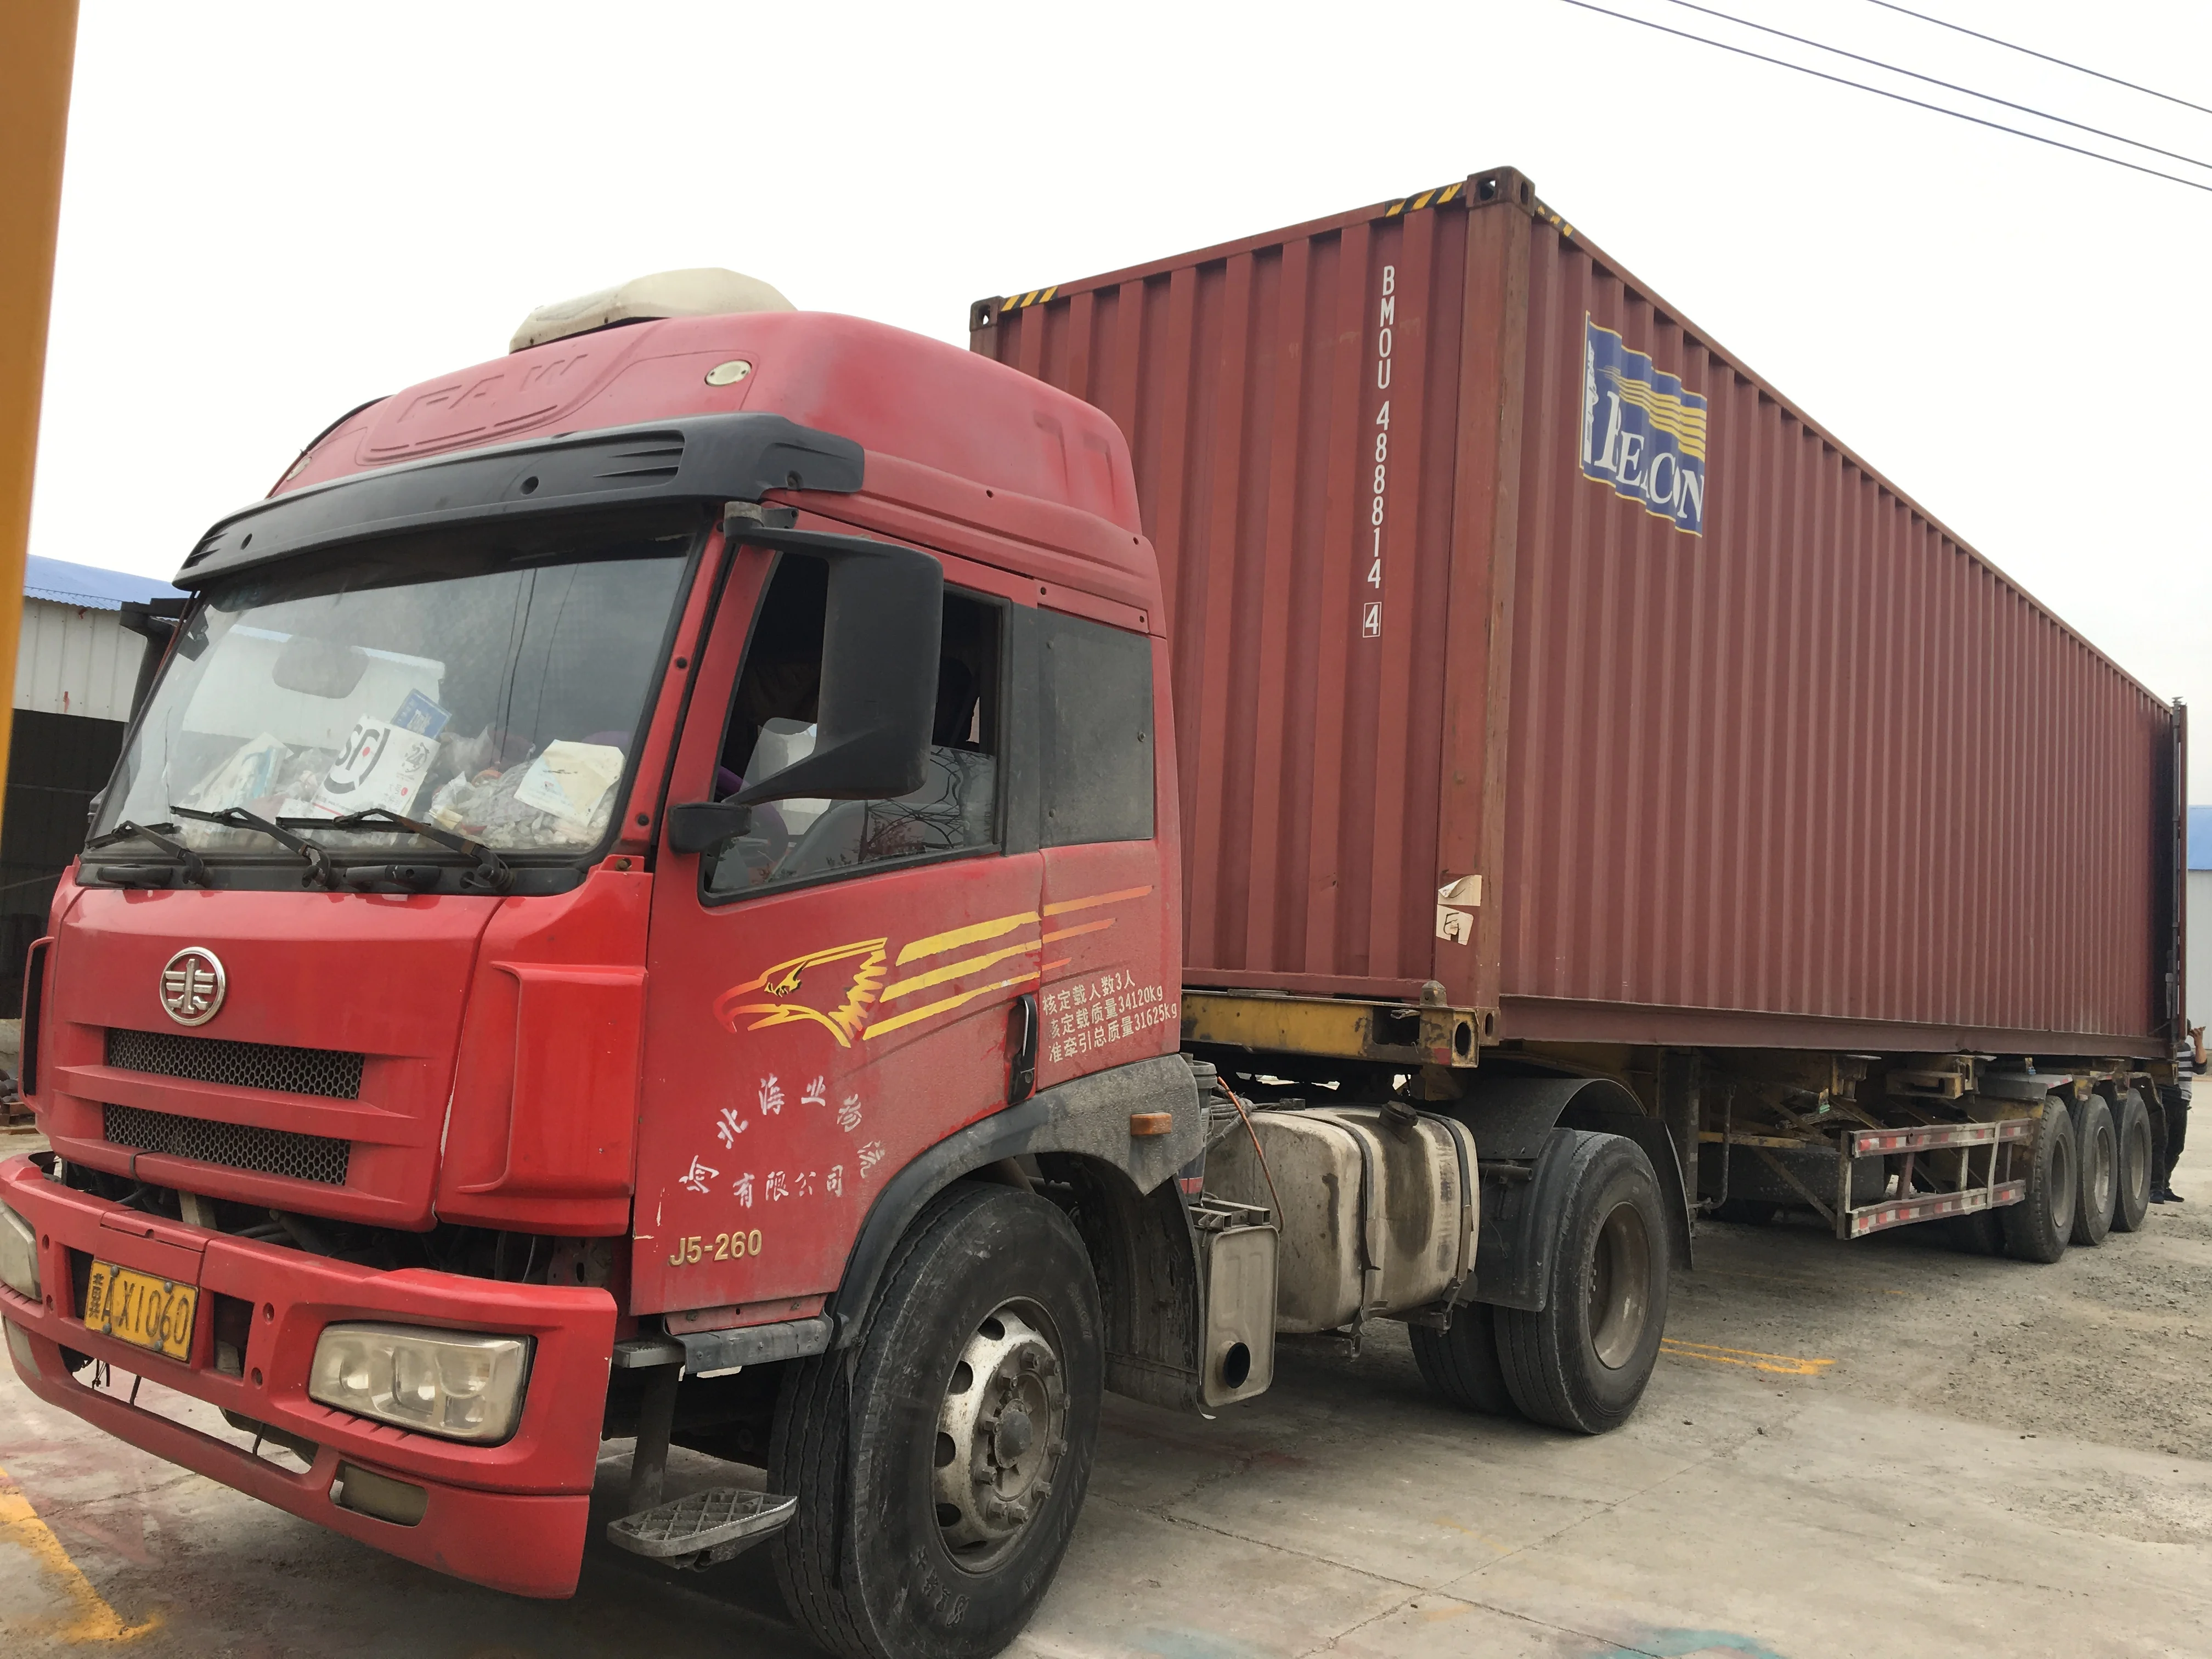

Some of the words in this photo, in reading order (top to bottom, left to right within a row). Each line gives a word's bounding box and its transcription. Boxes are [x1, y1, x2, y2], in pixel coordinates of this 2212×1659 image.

[1378, 266, 1395, 389] BMOU
[1594, 391, 1705, 522] ECN
[1368, 400, 1390, 589] 488814
[1365, 605, 1379, 635] 4
[1042, 969, 1136, 1015] 核定载人数3人
[733, 1165, 844, 1208] 有限公司
[669, 1228, 763, 1267] J5-260
